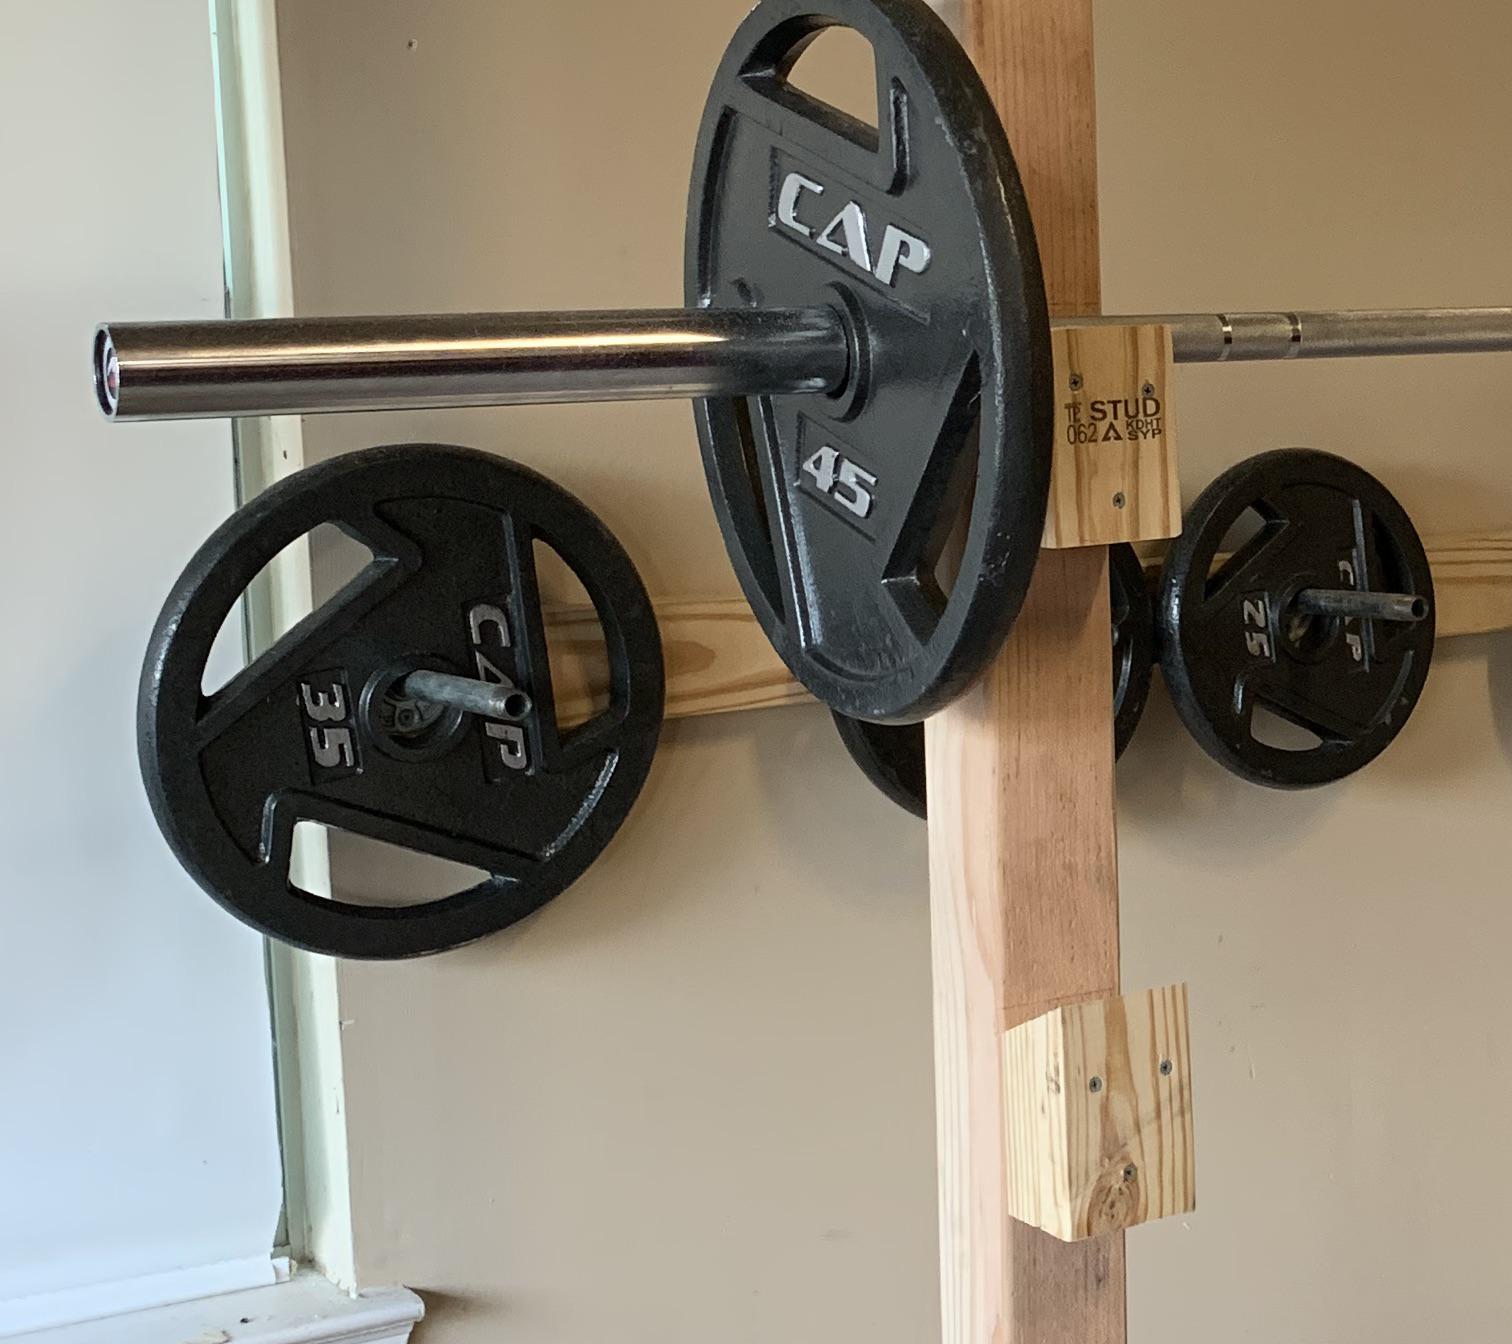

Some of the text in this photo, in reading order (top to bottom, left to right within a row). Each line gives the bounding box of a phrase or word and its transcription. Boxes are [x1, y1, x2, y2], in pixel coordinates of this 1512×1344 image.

[777, 171, 932, 287] CAP
[1066, 422, 1098, 445] 062
[1090, 397, 1161, 422] STUD
[1126, 417, 1162, 431] KDHT
[1127, 428, 1162, 441] SYP
[801, 443, 879, 520] 45
[1240, 597, 1270, 658] 25
[1337, 558, 1362, 662] CP
[301, 681, 357, 769] 35
